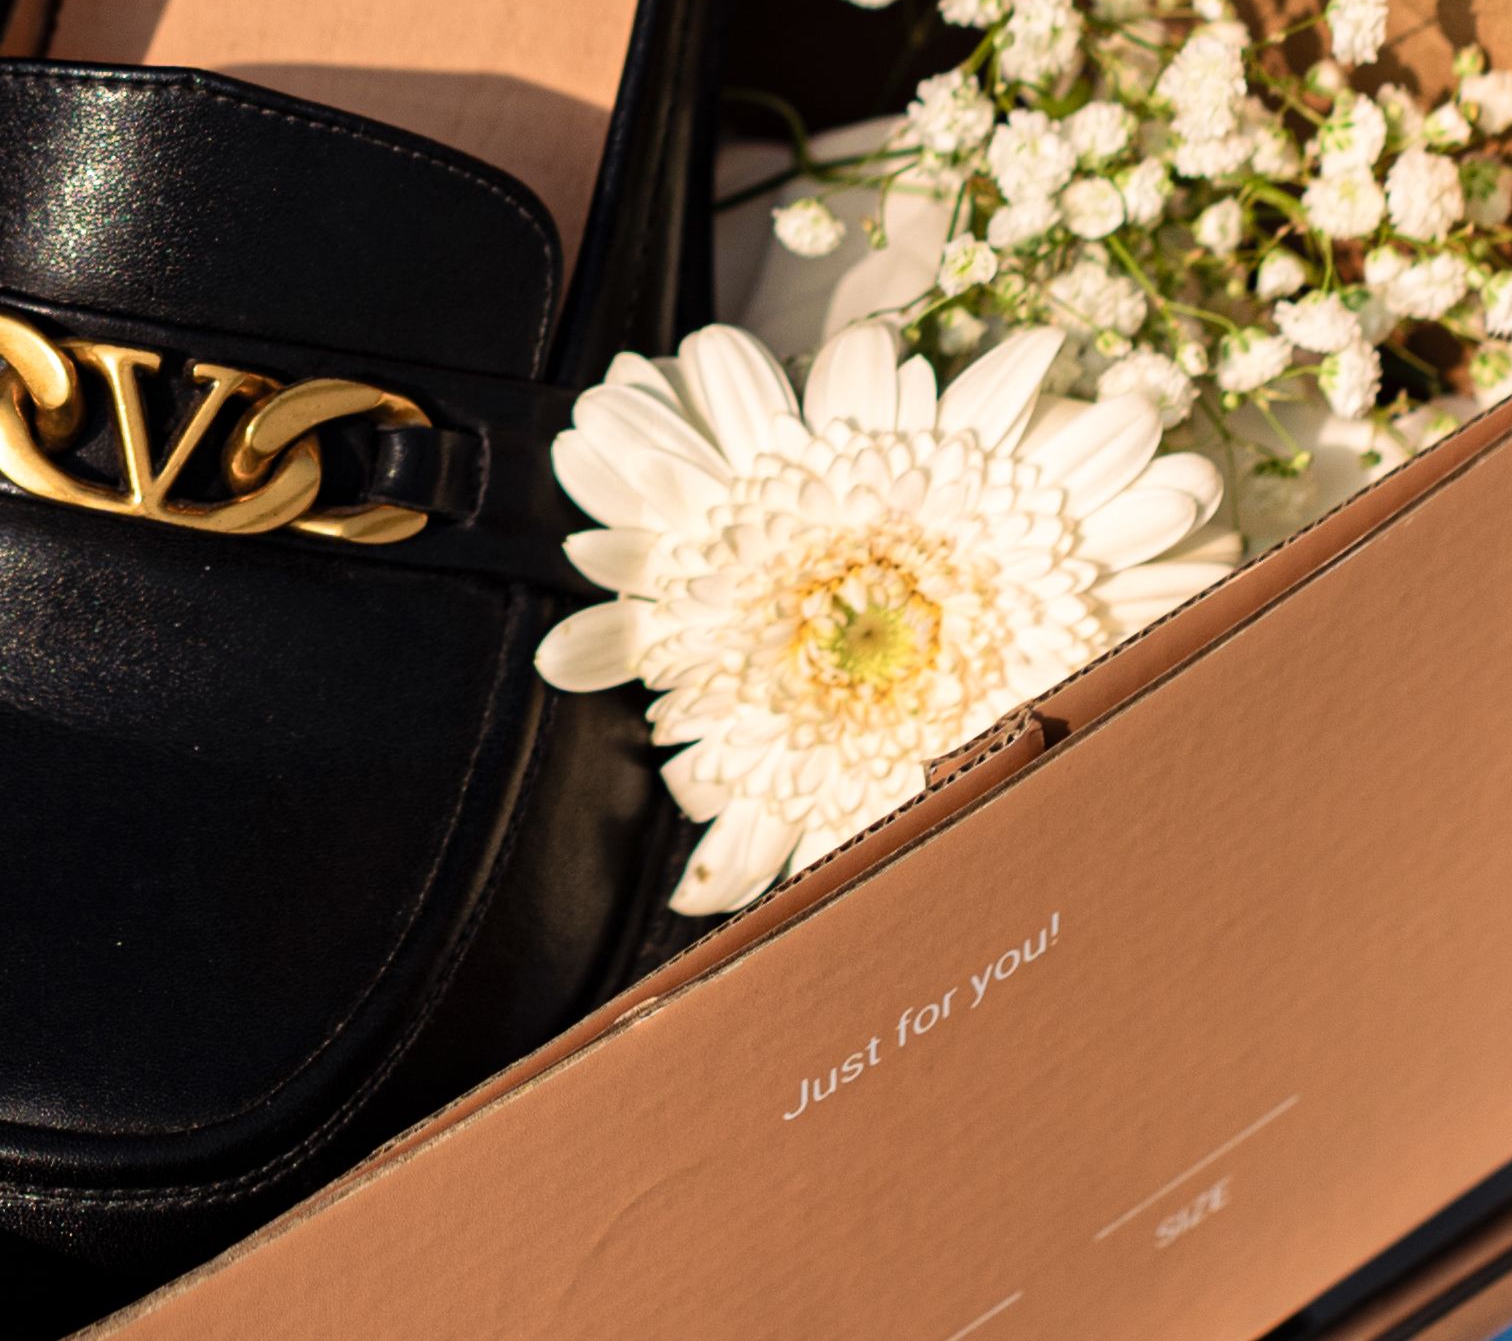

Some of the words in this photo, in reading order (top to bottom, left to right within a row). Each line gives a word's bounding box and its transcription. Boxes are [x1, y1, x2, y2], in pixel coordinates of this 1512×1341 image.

[782, 1036, 881, 1121] Just
[895, 986, 958, 1048] for
[970, 911, 1060, 1009] you!
[1155, 1175, 1232, 1248] SIZE
